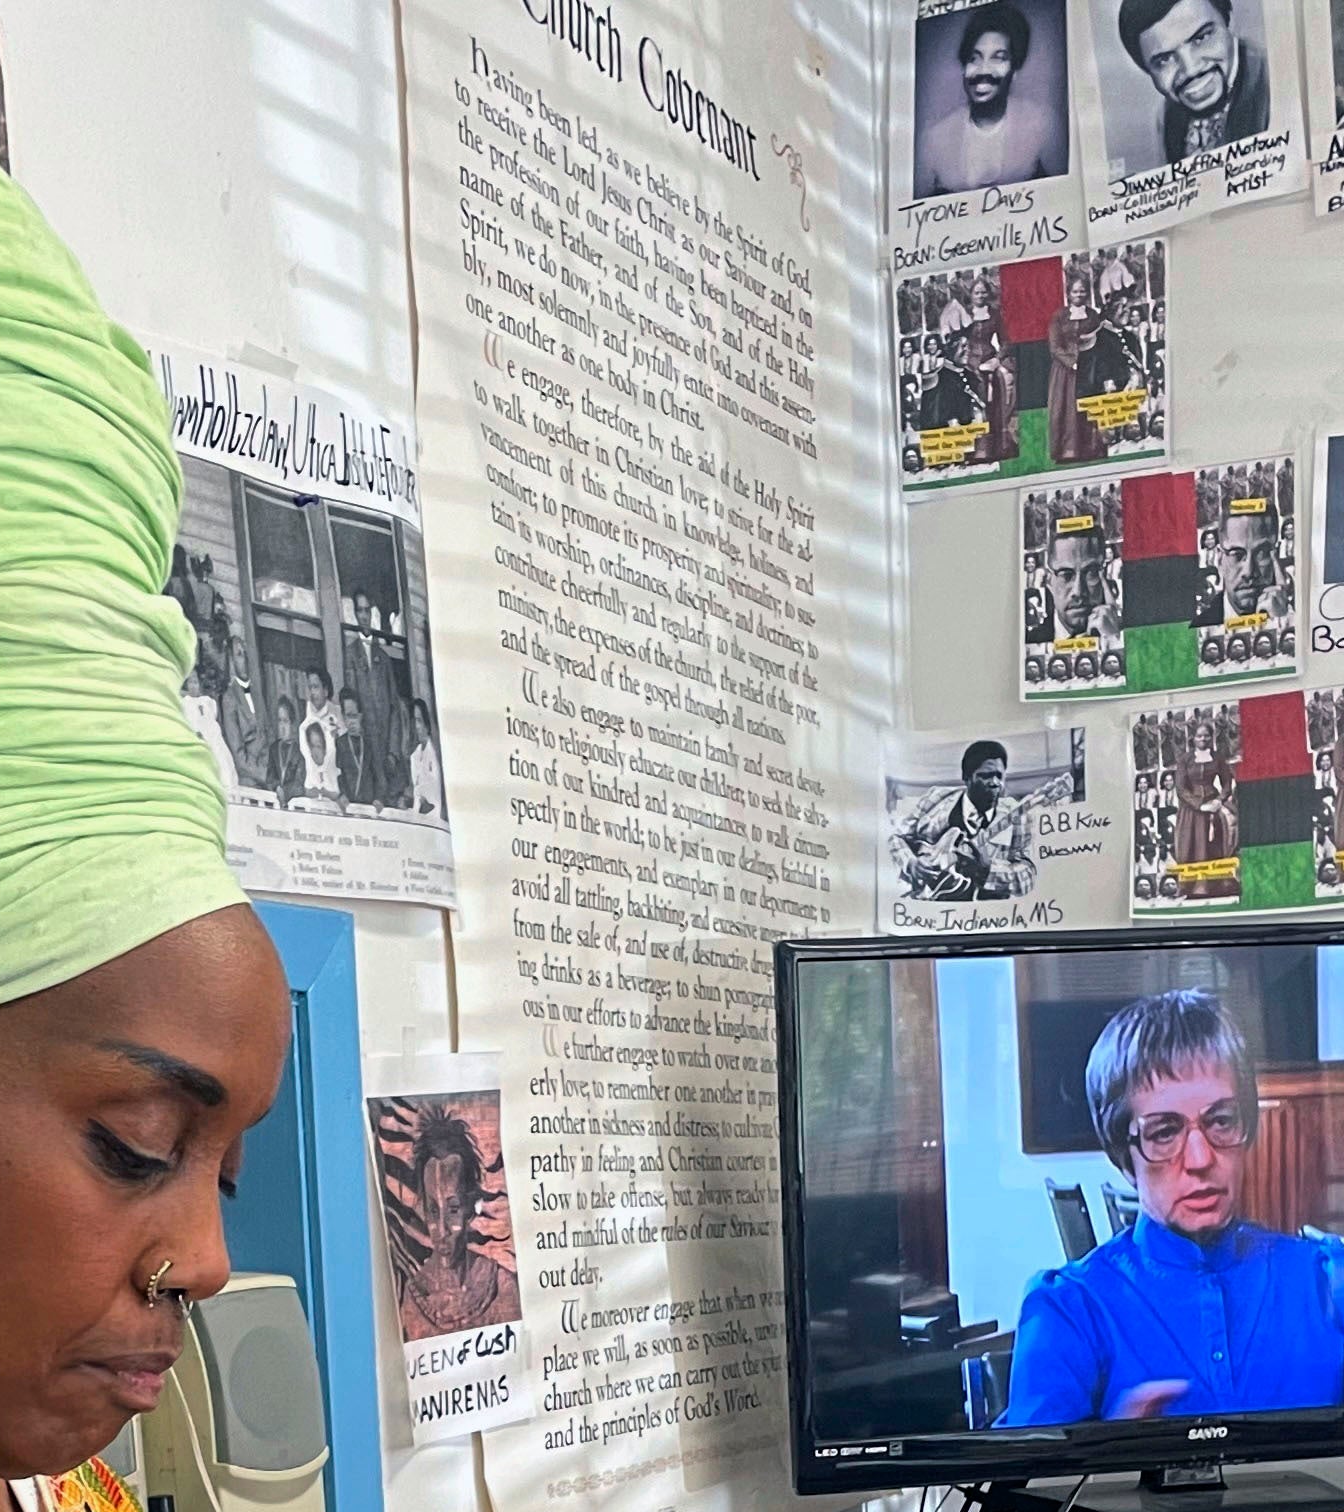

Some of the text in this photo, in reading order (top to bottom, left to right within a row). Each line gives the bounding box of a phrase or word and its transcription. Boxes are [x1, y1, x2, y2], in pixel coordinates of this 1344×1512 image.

[455, 78, 632, 216] to receive the Lord Jesus
[537, 89, 602, 162] been led,
[458, 115, 649, 266] the profession of our faith,
[459, 165, 607, 274] name of the Father,
[460, 197, 556, 278] Spirit, we do
[1030, 217, 1068, 244] MS
[466, 291, 576, 365] one another as
[1029, 900, 1062, 925] MS
[531, 1143, 636, 1179] pathy in feeling
[532, 1182, 572, 1212] slow
[536, 1221, 619, 1250] and mindful
[539, 1256, 603, 1291] out delay.
[543, 1334, 630, 1380] place we will,
[544, 1370, 682, 1413] church where we can
[545, 1395, 720, 1450] and the principles of God's
[1188, 1426, 1228, 1439] SANYO
[815, 1448, 838, 1458] LED
